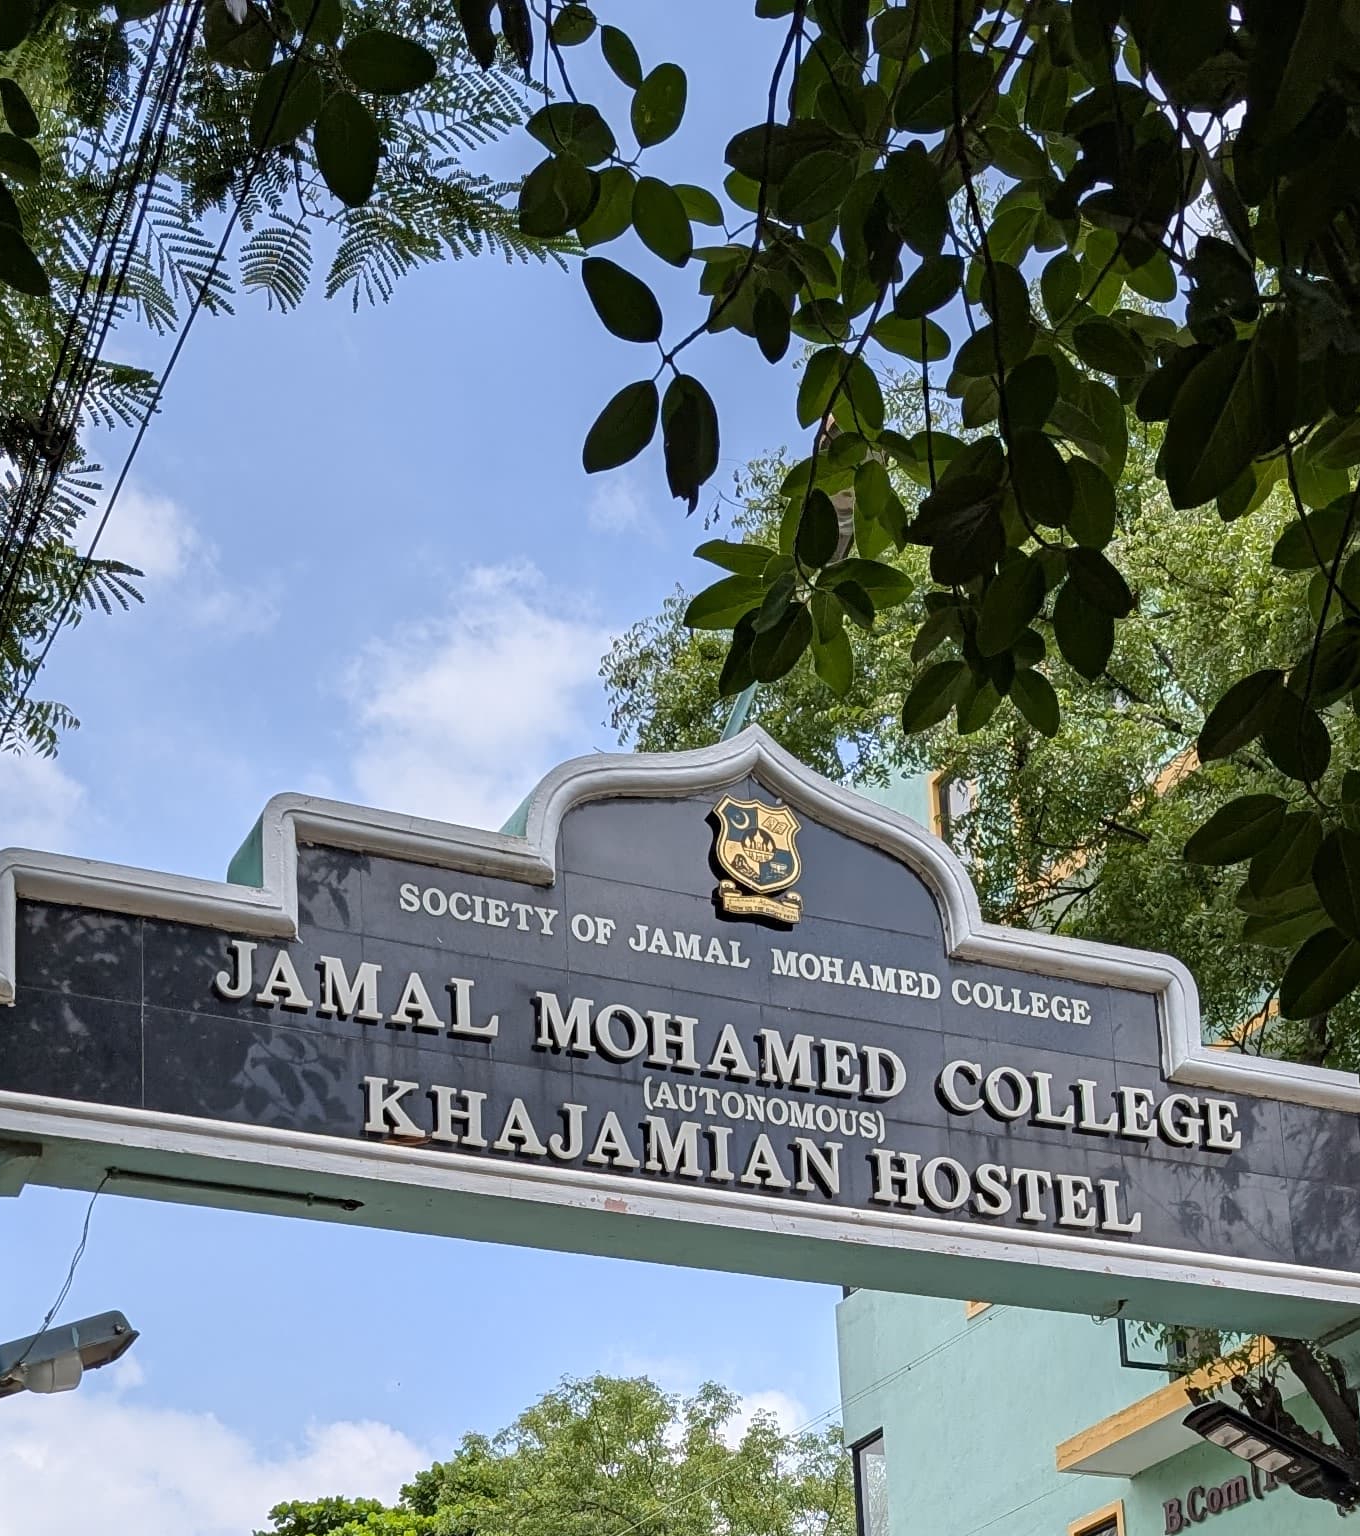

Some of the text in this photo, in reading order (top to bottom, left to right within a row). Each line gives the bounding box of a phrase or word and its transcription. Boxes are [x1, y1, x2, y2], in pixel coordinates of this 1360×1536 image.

[399, 882, 1093, 1026] SOCIETY OF JAMAL MOHAMED COLLEGE
[215, 939, 1242, 1151] JAMAL MOHAMED COLLEGE
[643, 1075, 885, 1144] (AUTONOMOUS)
[363, 1076, 1141, 1234] KHAJAMIAN HOSTEL
